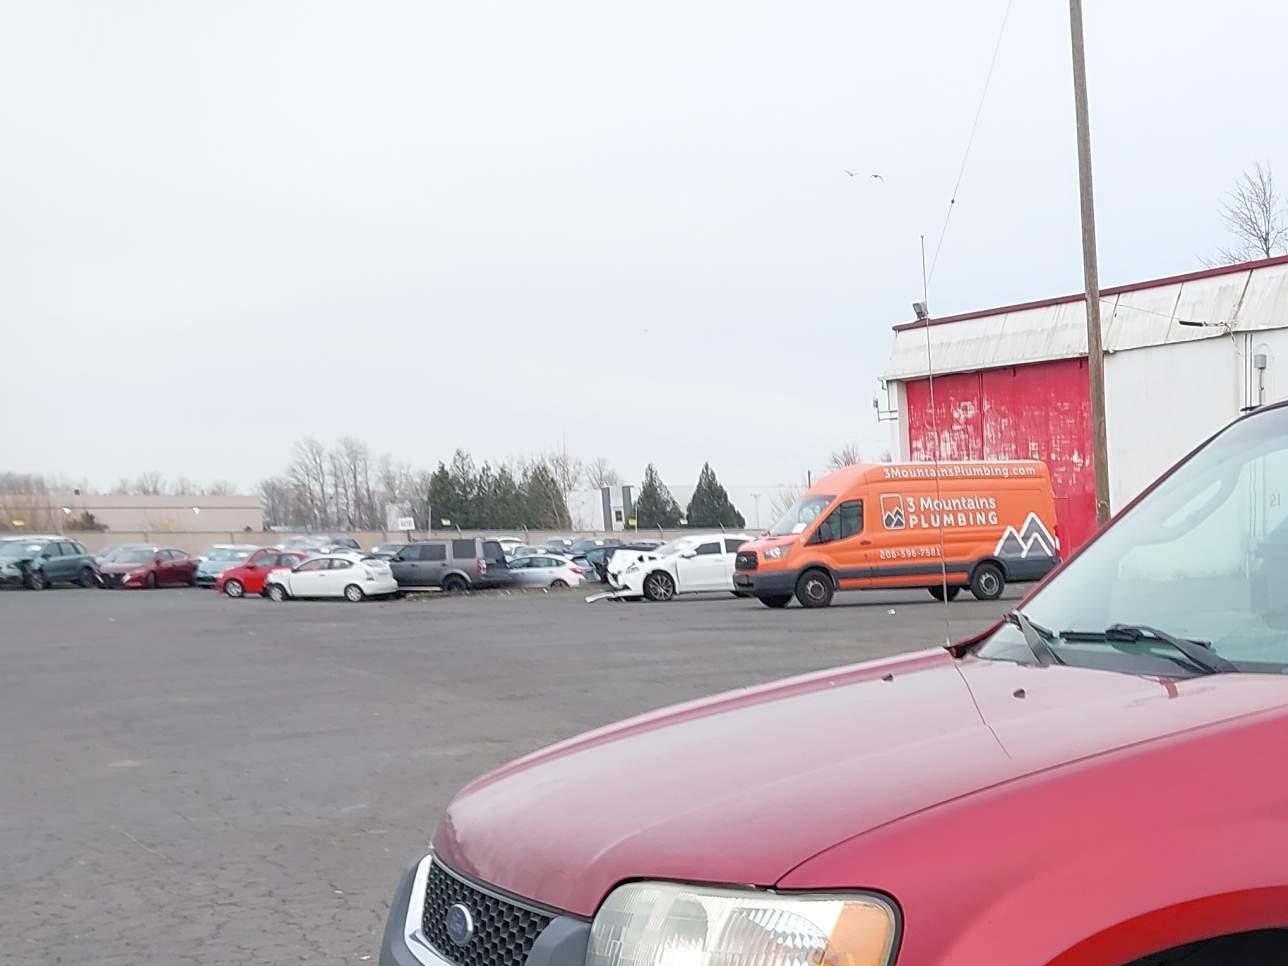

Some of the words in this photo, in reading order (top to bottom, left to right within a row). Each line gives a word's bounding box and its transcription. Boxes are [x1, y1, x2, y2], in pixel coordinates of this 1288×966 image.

[884, 465, 1036, 479] 3MountainsPlumbing.com
[907, 497, 916, 512] 3
[920, 496, 996, 511] Mountains
[909, 512, 998, 528] PLUMBING
